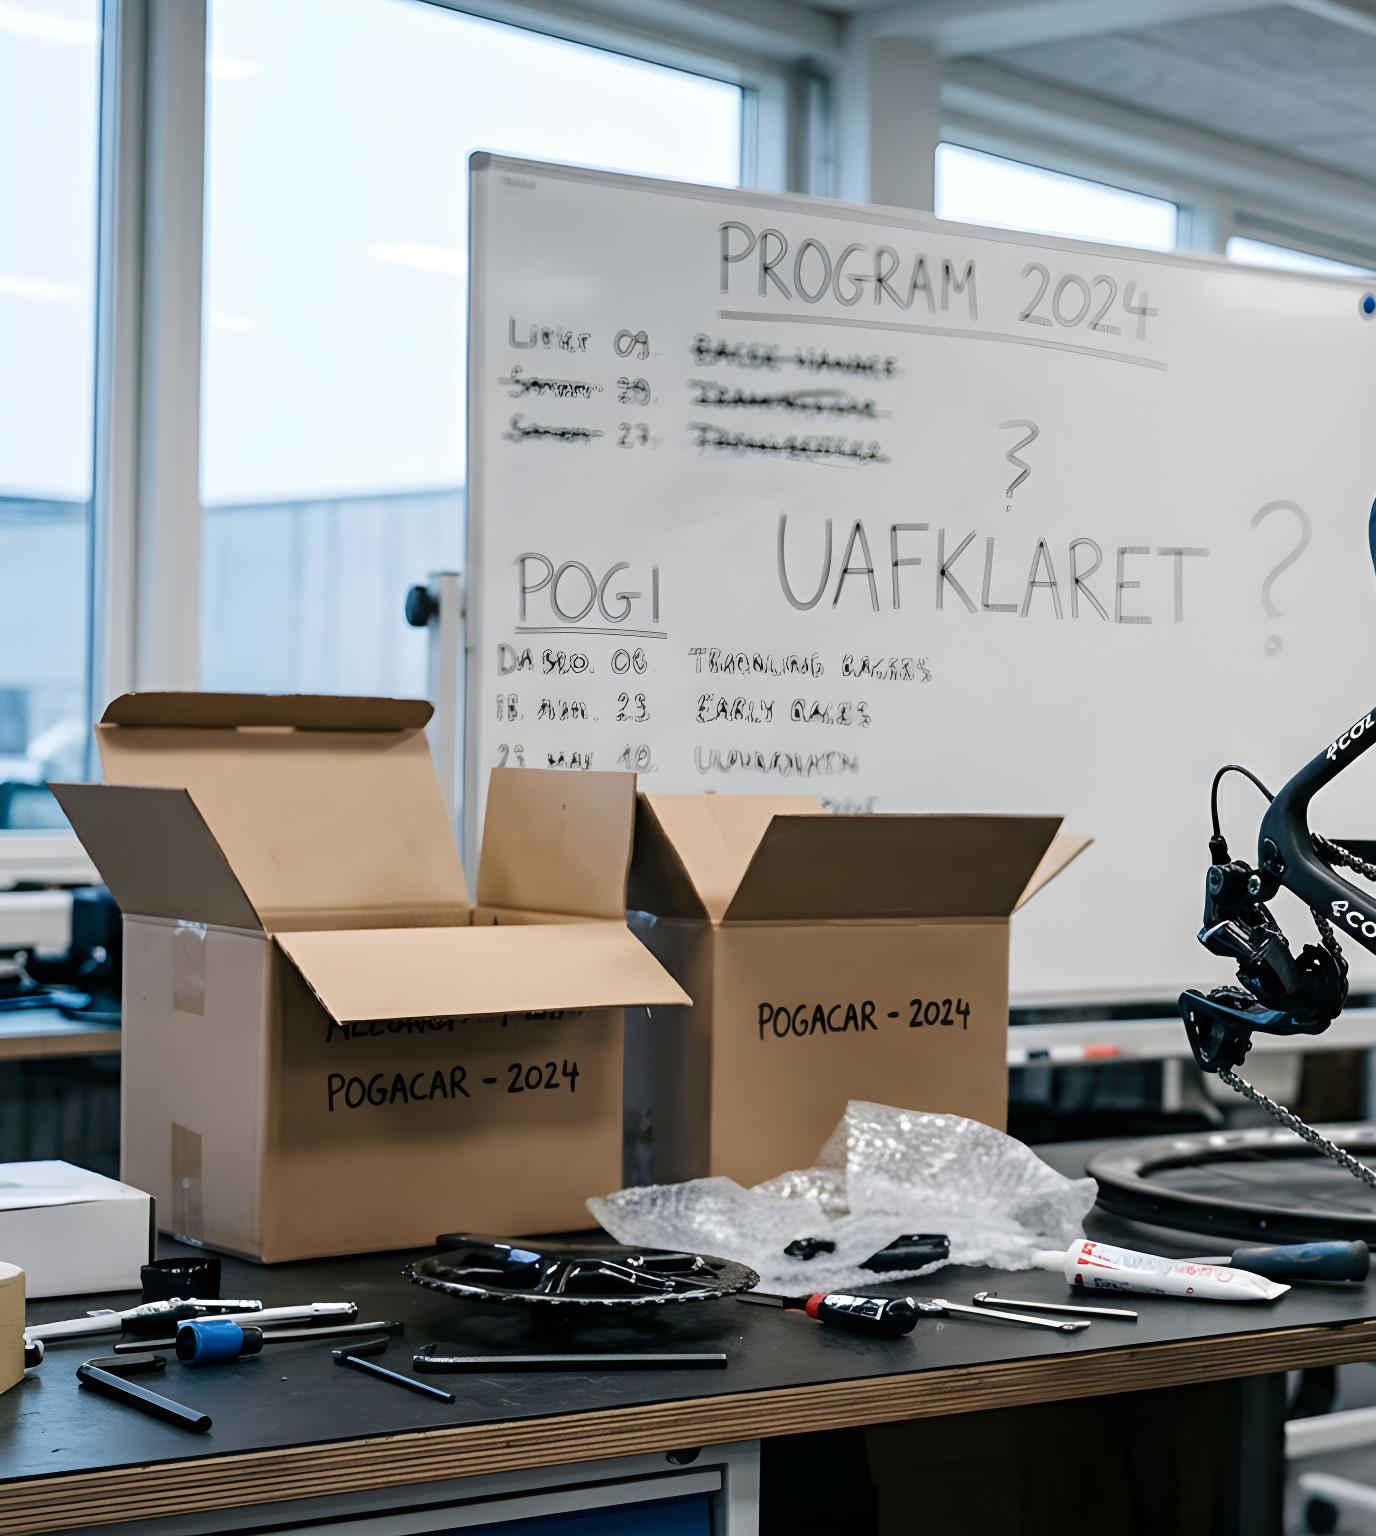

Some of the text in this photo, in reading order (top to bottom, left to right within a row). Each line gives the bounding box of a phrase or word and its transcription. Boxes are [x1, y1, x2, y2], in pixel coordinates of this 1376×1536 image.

[718, 221, 1159, 341] PROGRAM 2024
[516, 551, 661, 624] POGI
[776, 499, 1312, 658] UAFKLARET ?
[758, 1000, 878, 1041] POGACAR
[908, 997, 971, 1031] 2024
[327, 1065, 471, 1112] POGACAR
[506, 1059, 580, 1094] 2024
